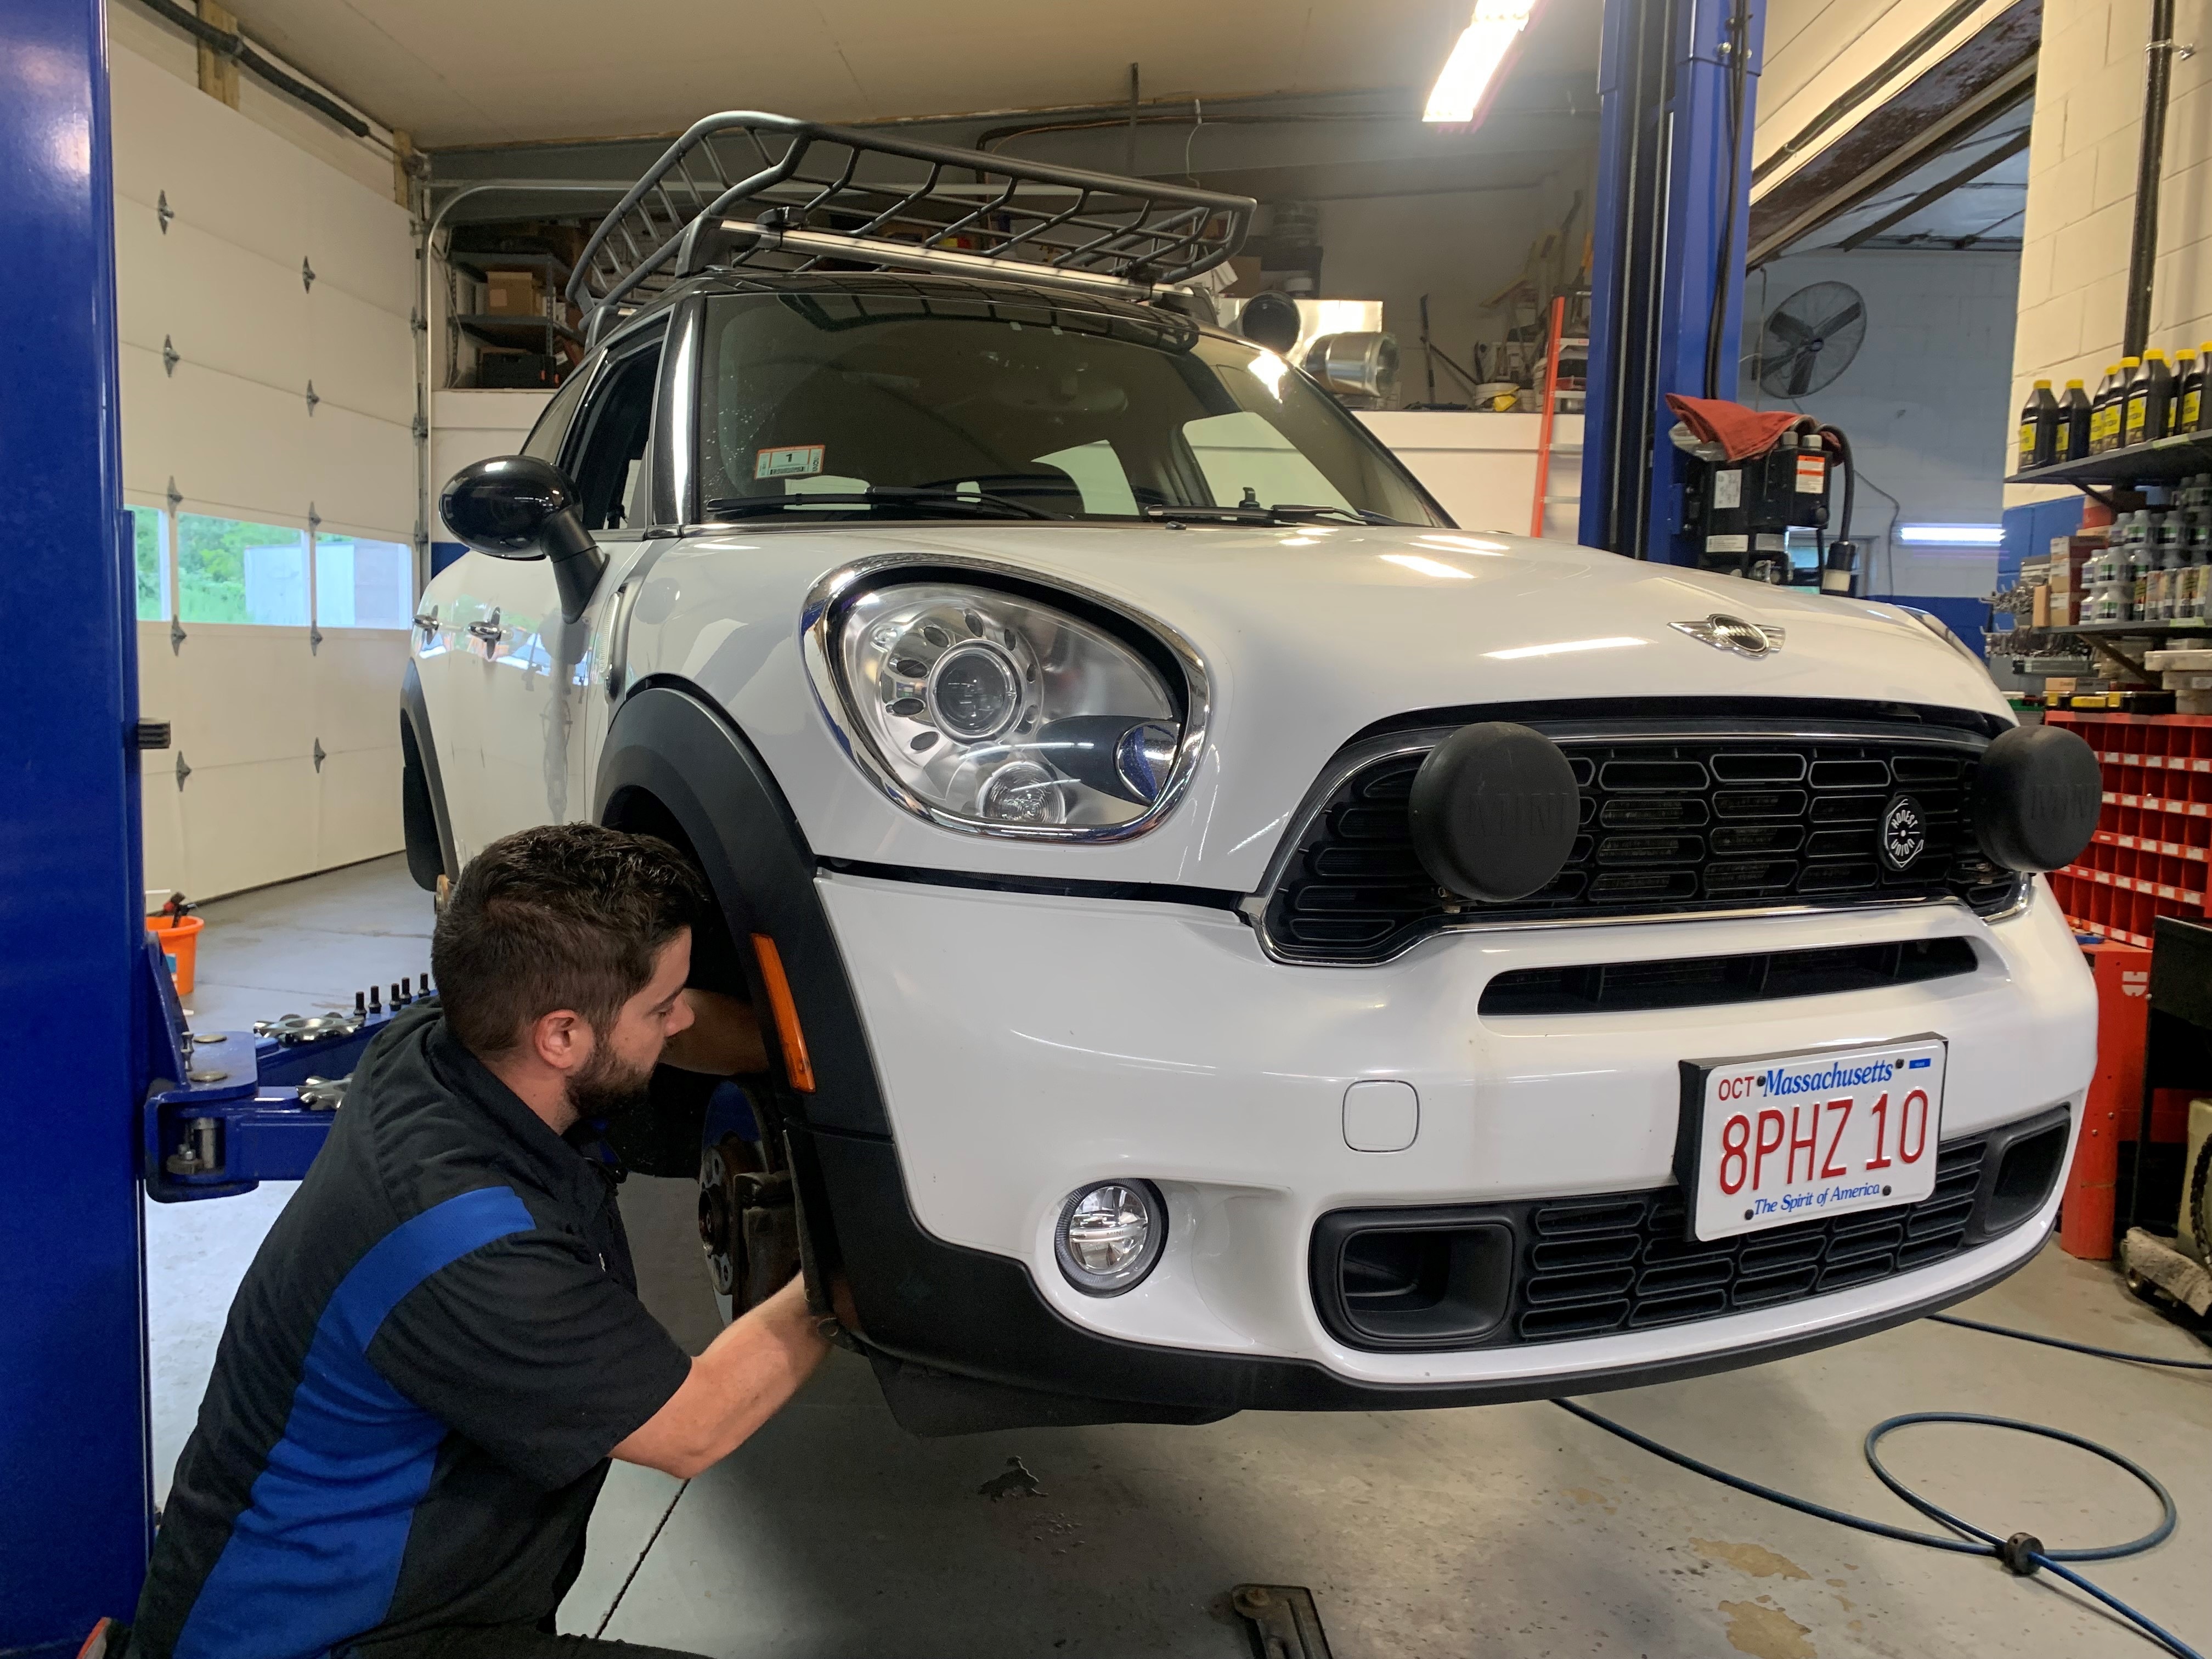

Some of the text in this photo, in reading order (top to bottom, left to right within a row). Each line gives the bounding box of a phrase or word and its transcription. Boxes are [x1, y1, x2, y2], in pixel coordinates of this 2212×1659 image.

[785, 453, 793, 462] 1
[1718, 1060, 1894, 1101] OCT Massachusetts
[1719, 1088, 1929, 1196] 8PHZ 10
[1754, 1182, 1880, 1215] The Spirit of America
